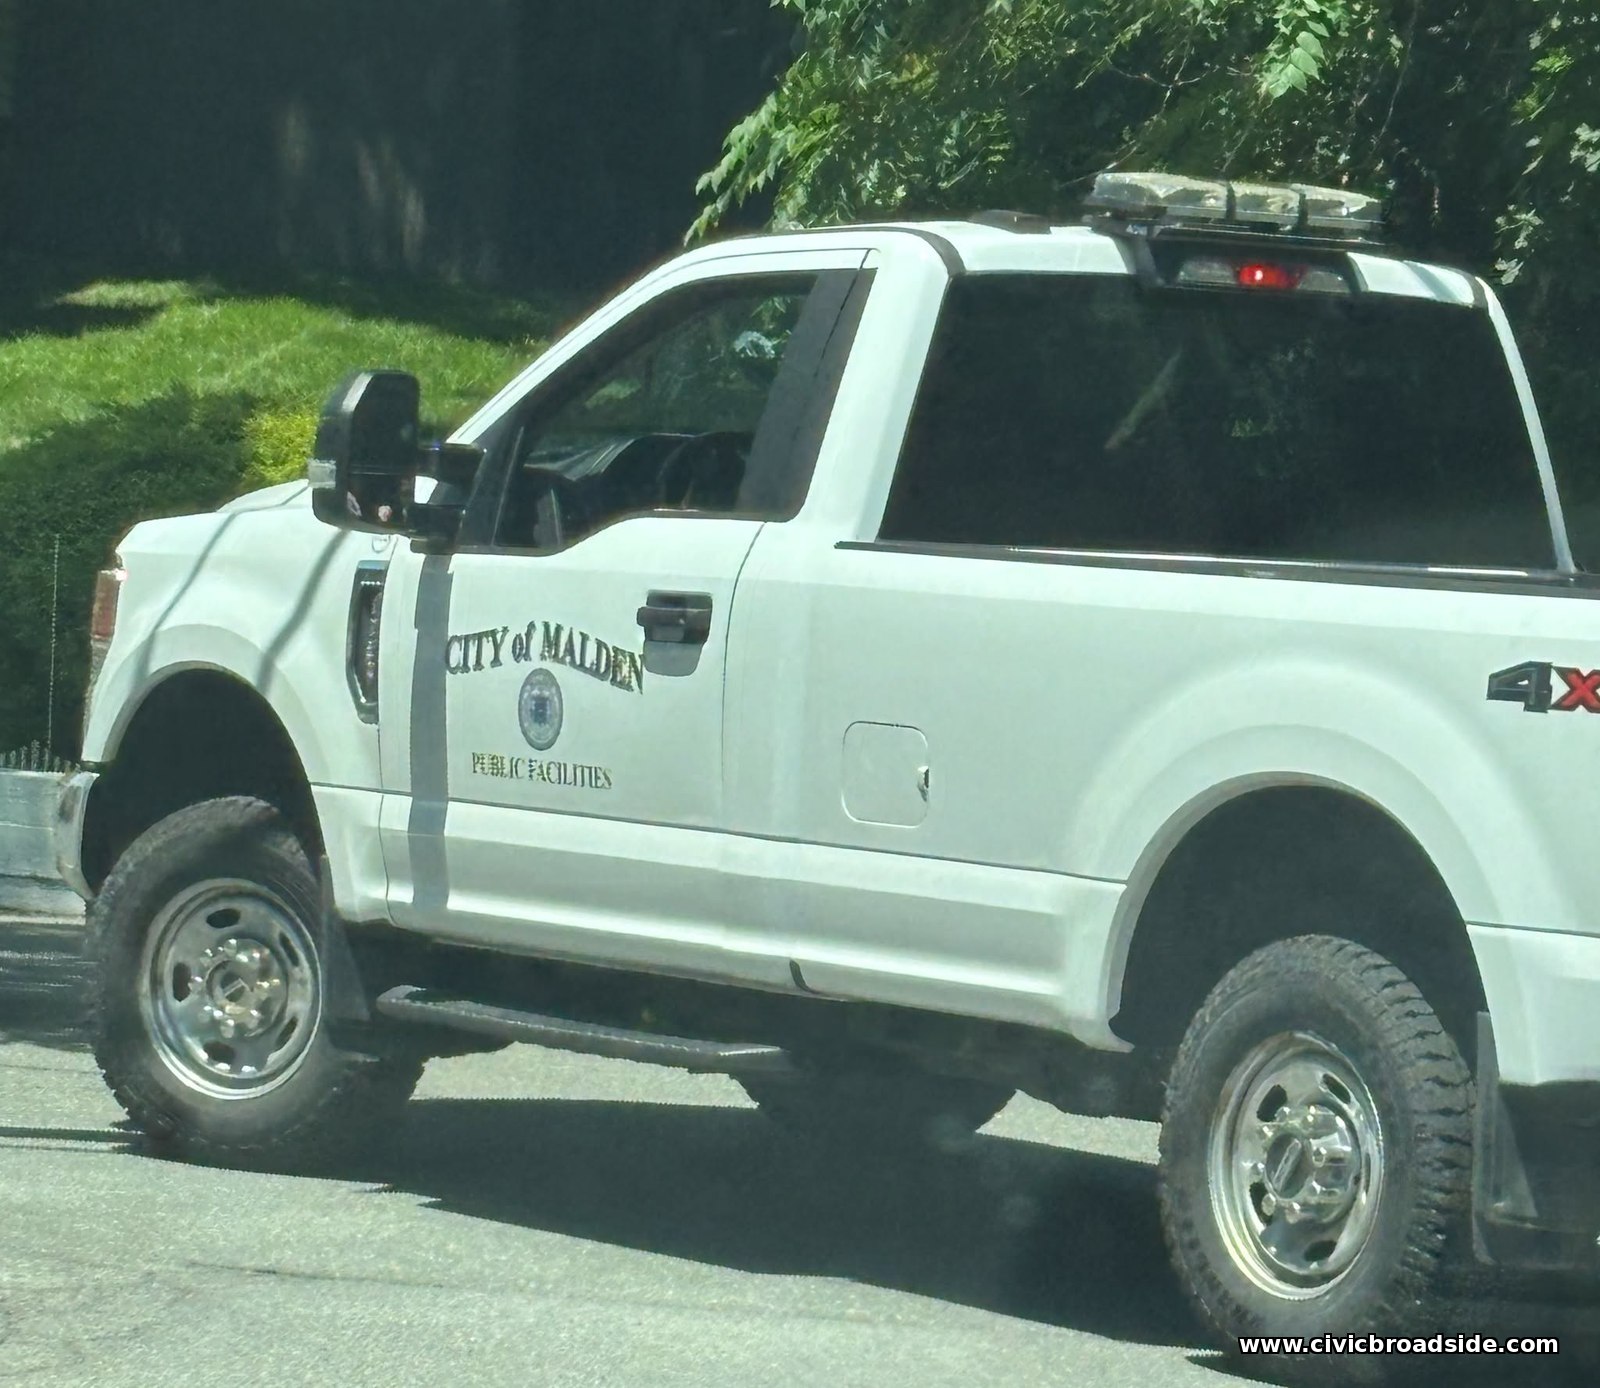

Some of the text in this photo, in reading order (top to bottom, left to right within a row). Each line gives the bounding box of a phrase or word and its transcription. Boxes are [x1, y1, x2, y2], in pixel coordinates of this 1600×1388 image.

[445, 620, 645, 695] CITY of MALDEN
[471, 752, 613, 790] PUBLIC FACILITIES
